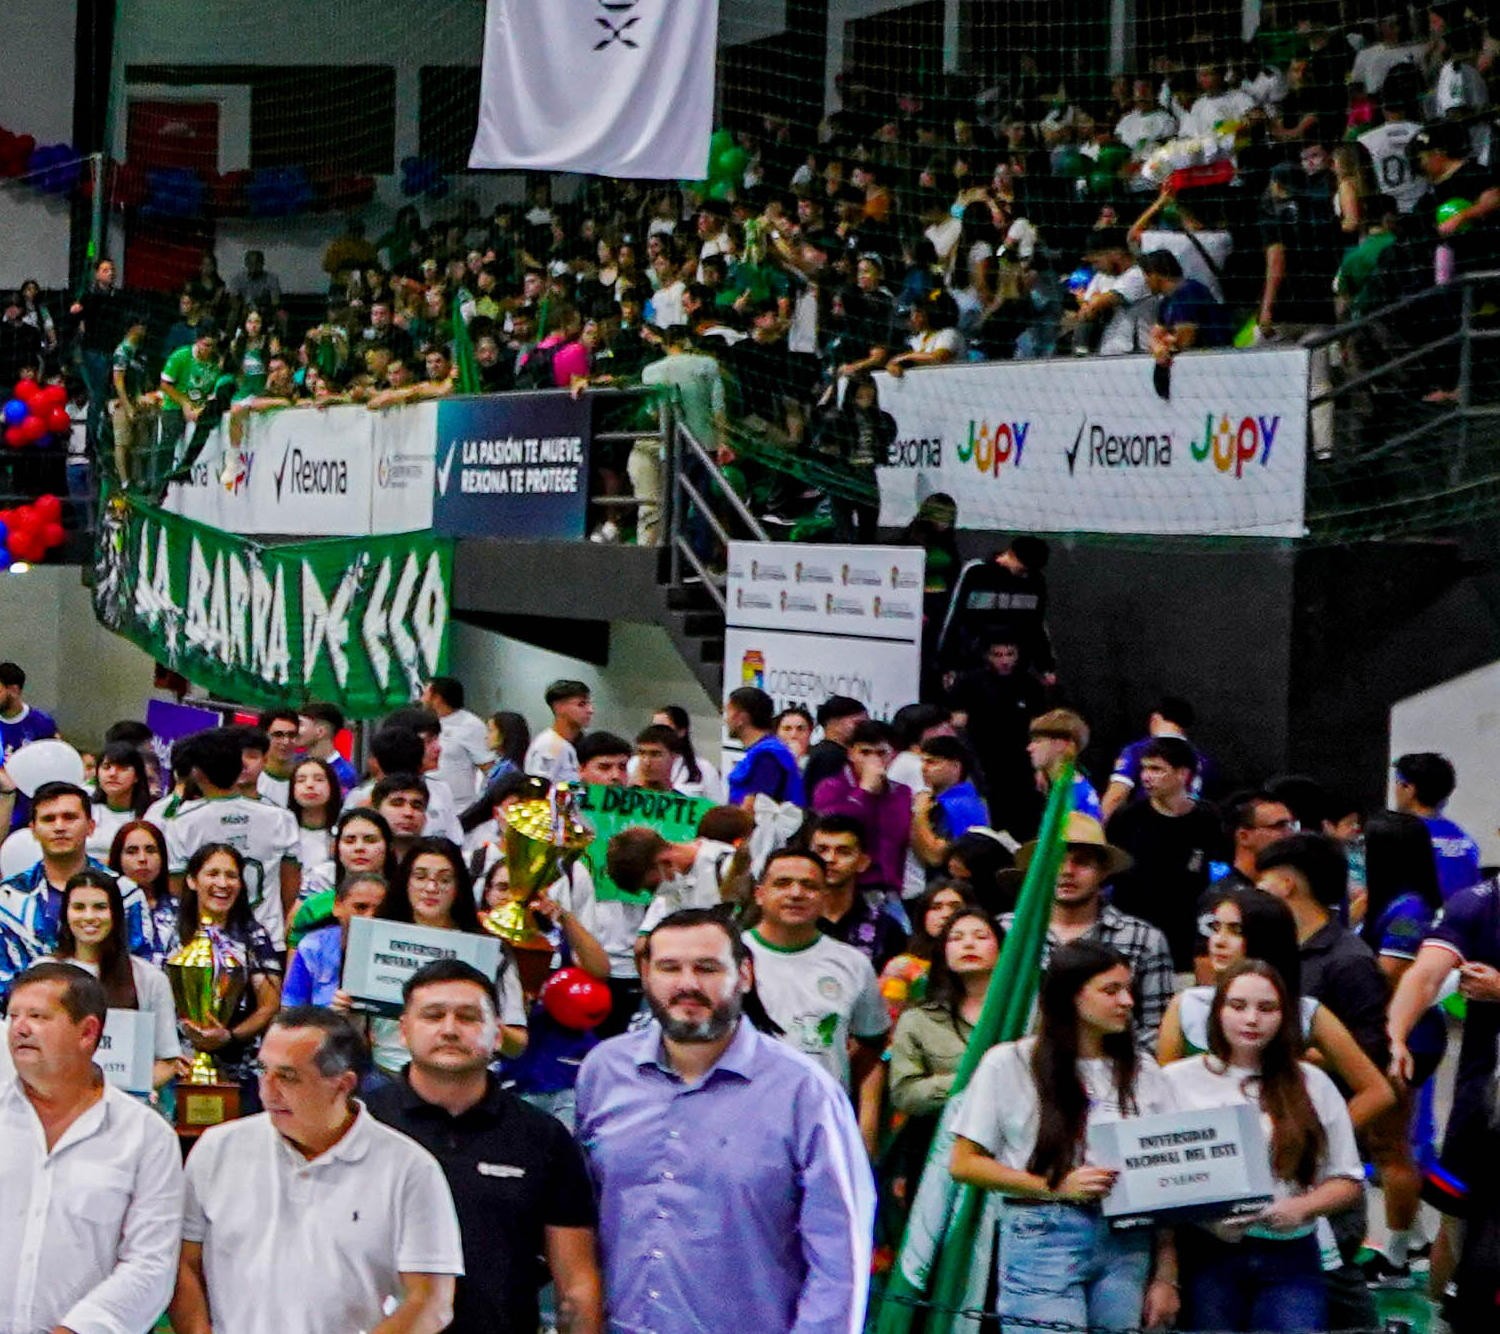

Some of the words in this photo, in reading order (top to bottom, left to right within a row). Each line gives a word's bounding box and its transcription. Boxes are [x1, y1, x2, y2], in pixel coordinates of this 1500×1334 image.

[462, 441, 478, 464] LA
[479, 436, 522, 464] PASIÓN
[524, 440, 538, 464] TE
[885, 433, 942, 467] exona
[1089, 425, 1172, 467] Rexona
[291, 448, 347, 494] Rexona
[461, 469, 507, 493] REXONA
[509, 469, 524, 492] TE
[526, 468, 578, 492] PROTEGE
[602, 785, 699, 827] DEPORTE
